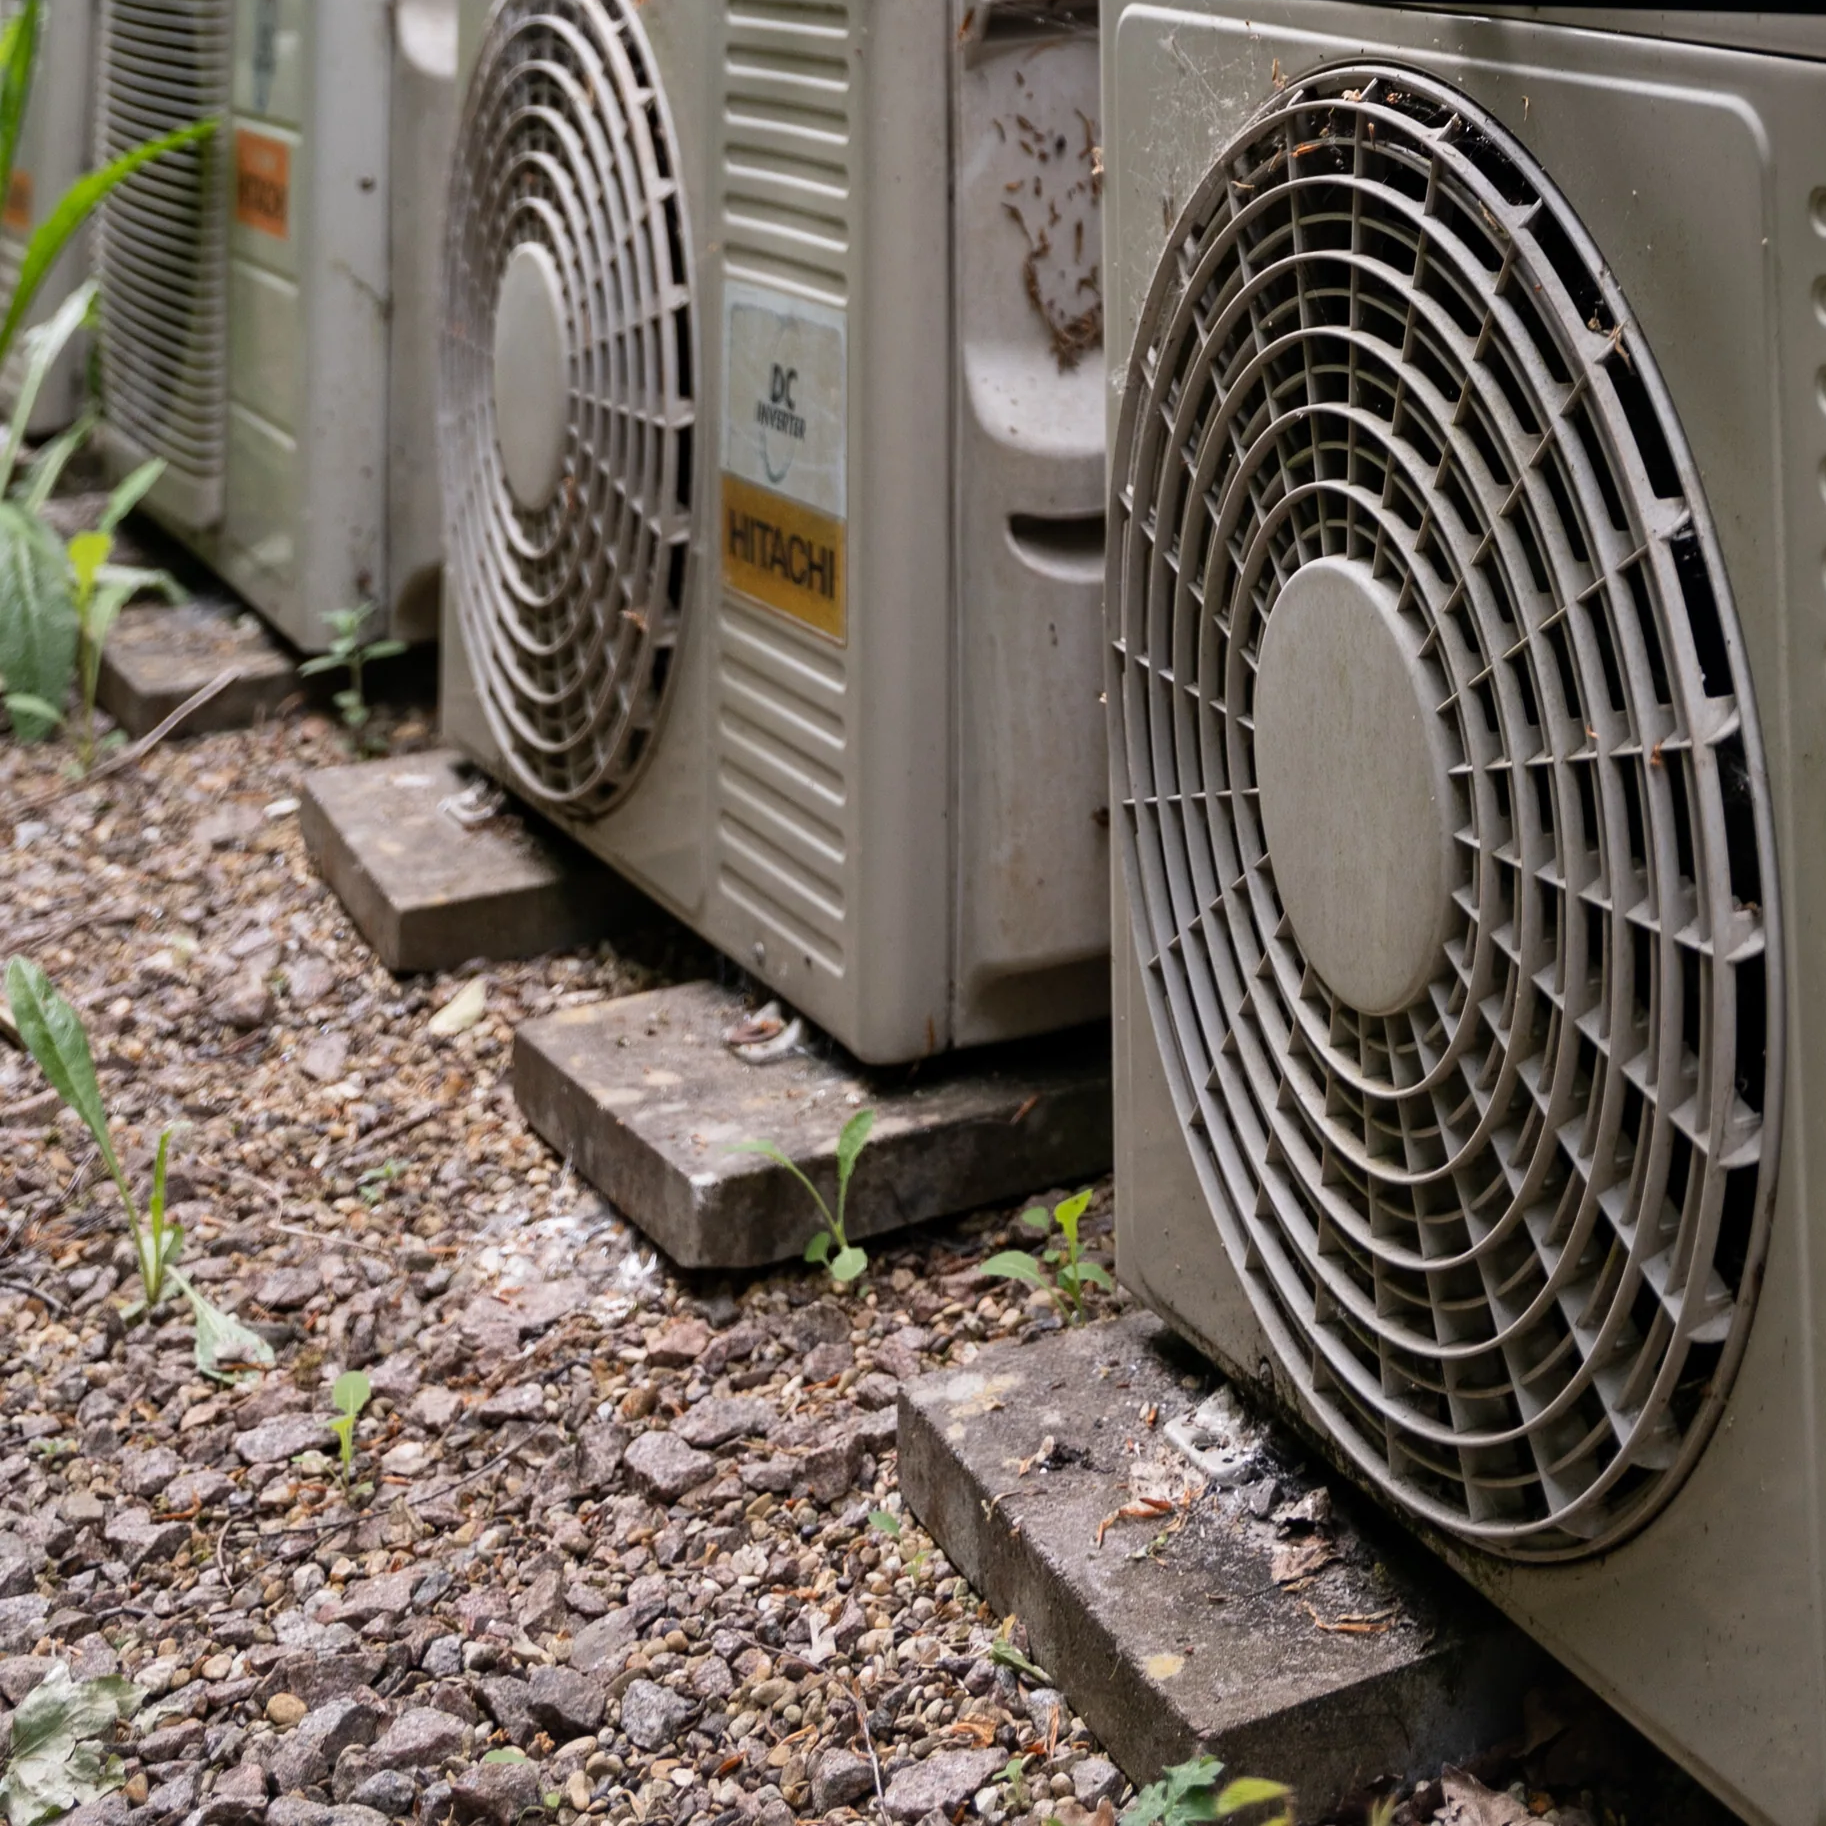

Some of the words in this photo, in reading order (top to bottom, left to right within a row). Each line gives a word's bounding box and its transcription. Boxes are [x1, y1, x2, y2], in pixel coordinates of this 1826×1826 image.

[771, 362, 798, 410] DC
[756, 399, 807, 440] INVERTER
[729, 507, 836, 601] HITACHI
